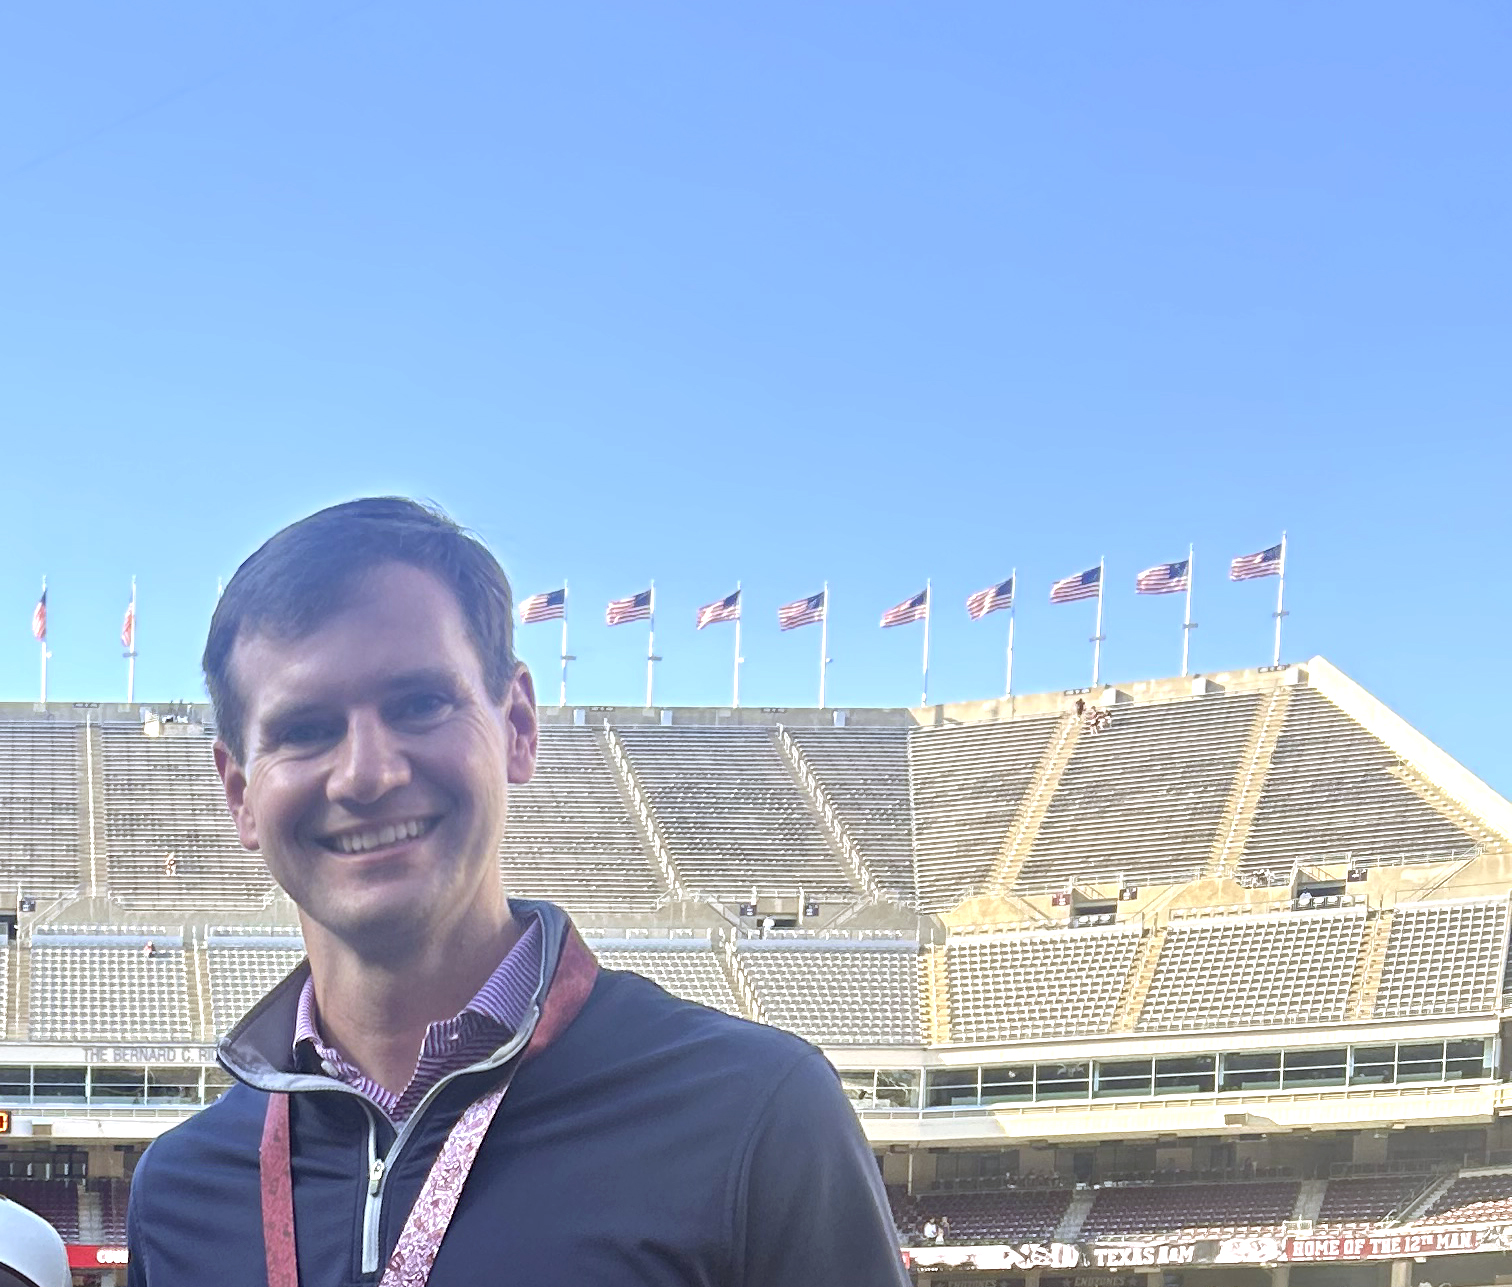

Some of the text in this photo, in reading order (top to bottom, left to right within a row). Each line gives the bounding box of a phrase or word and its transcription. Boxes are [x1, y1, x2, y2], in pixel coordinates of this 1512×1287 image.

[82, 1048, 107, 1062] THE
[113, 1048, 176, 1062] BERNARD
[1094, 1246, 1155, 1267] TEXAS
[1157, 1244, 1195, 1265] A&M
[1292, 1239, 1338, 1257] HOME
[1343, 1237, 1366, 1255] OF
[1369, 1235, 1400, 1254] THE
[1436, 1231, 1474, 1250] MAN
